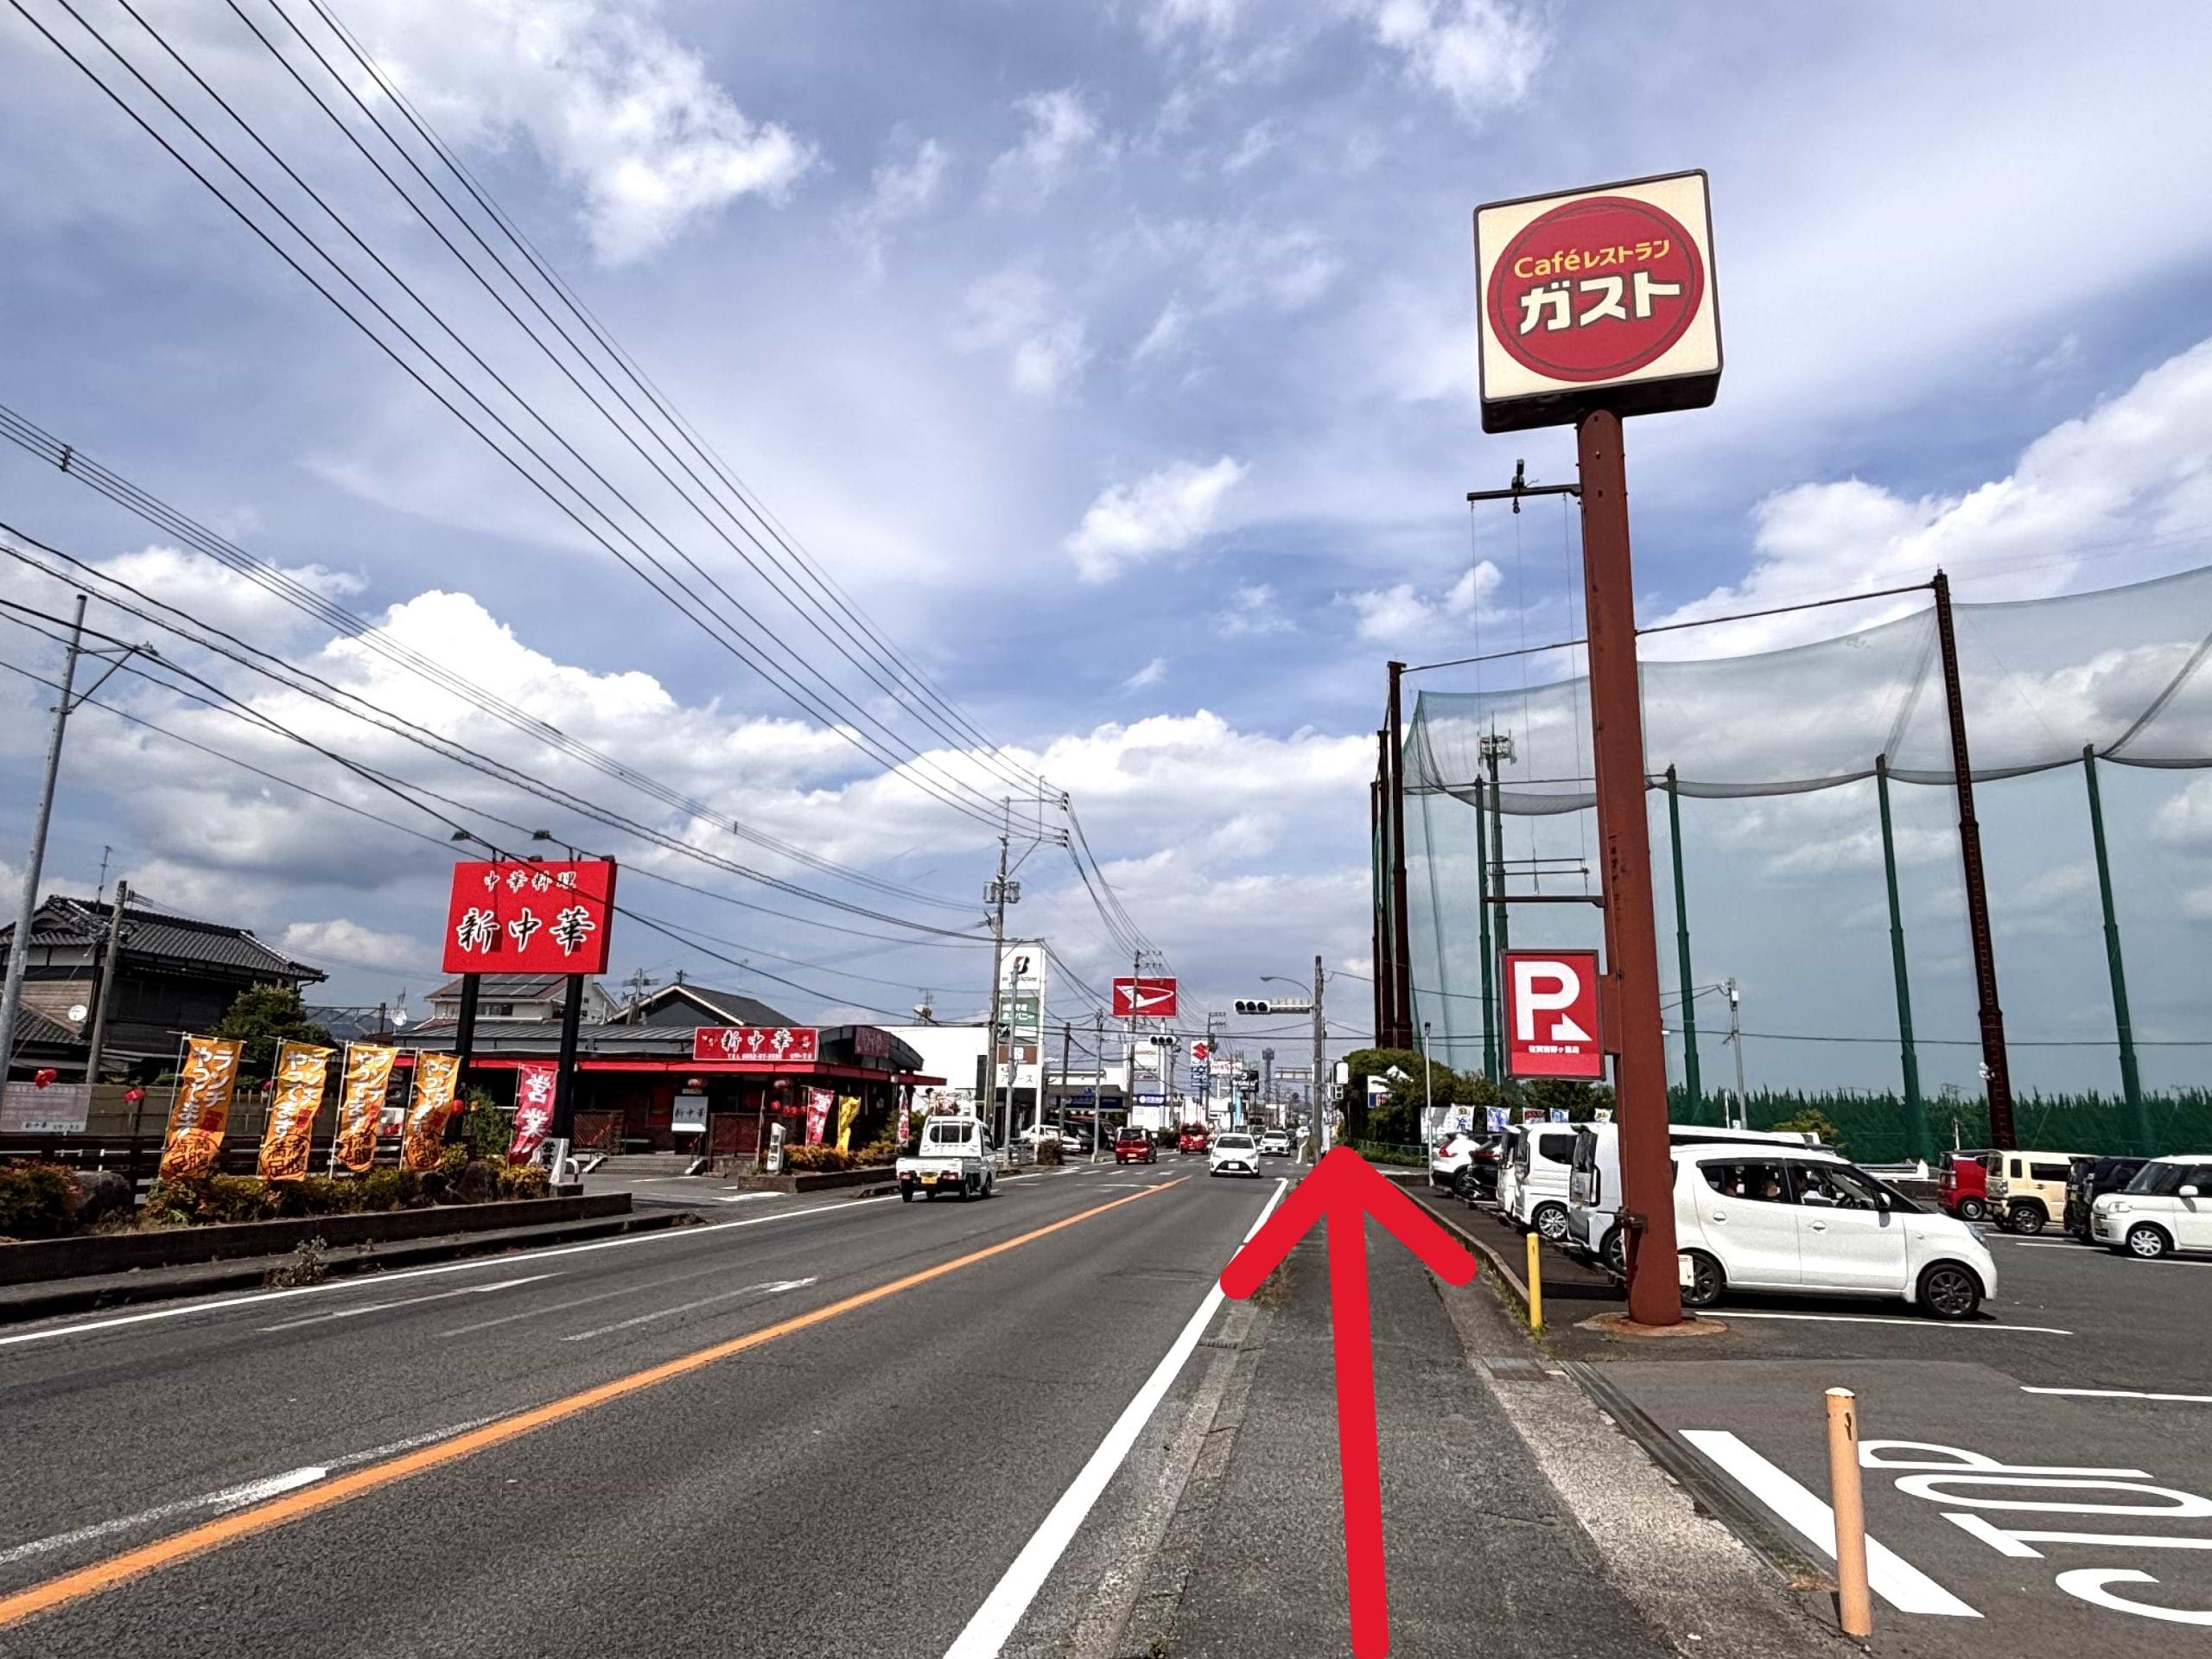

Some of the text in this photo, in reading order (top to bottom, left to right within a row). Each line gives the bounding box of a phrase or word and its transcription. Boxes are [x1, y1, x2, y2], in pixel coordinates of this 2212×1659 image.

[1519, 270, 1681, 336] ガスト
[484, 869, 577, 893] 中華料理
[456, 905, 596, 957] 新中華
[1514, 961, 1580, 1040] P
[721, 1029, 793, 1054] 新中華
[174, 1046, 213, 1140] やってます
[203, 1048, 234, 1109] ランチ
[273, 1049, 308, 1139] やってます
[511, 1073, 551, 1154] 営業
